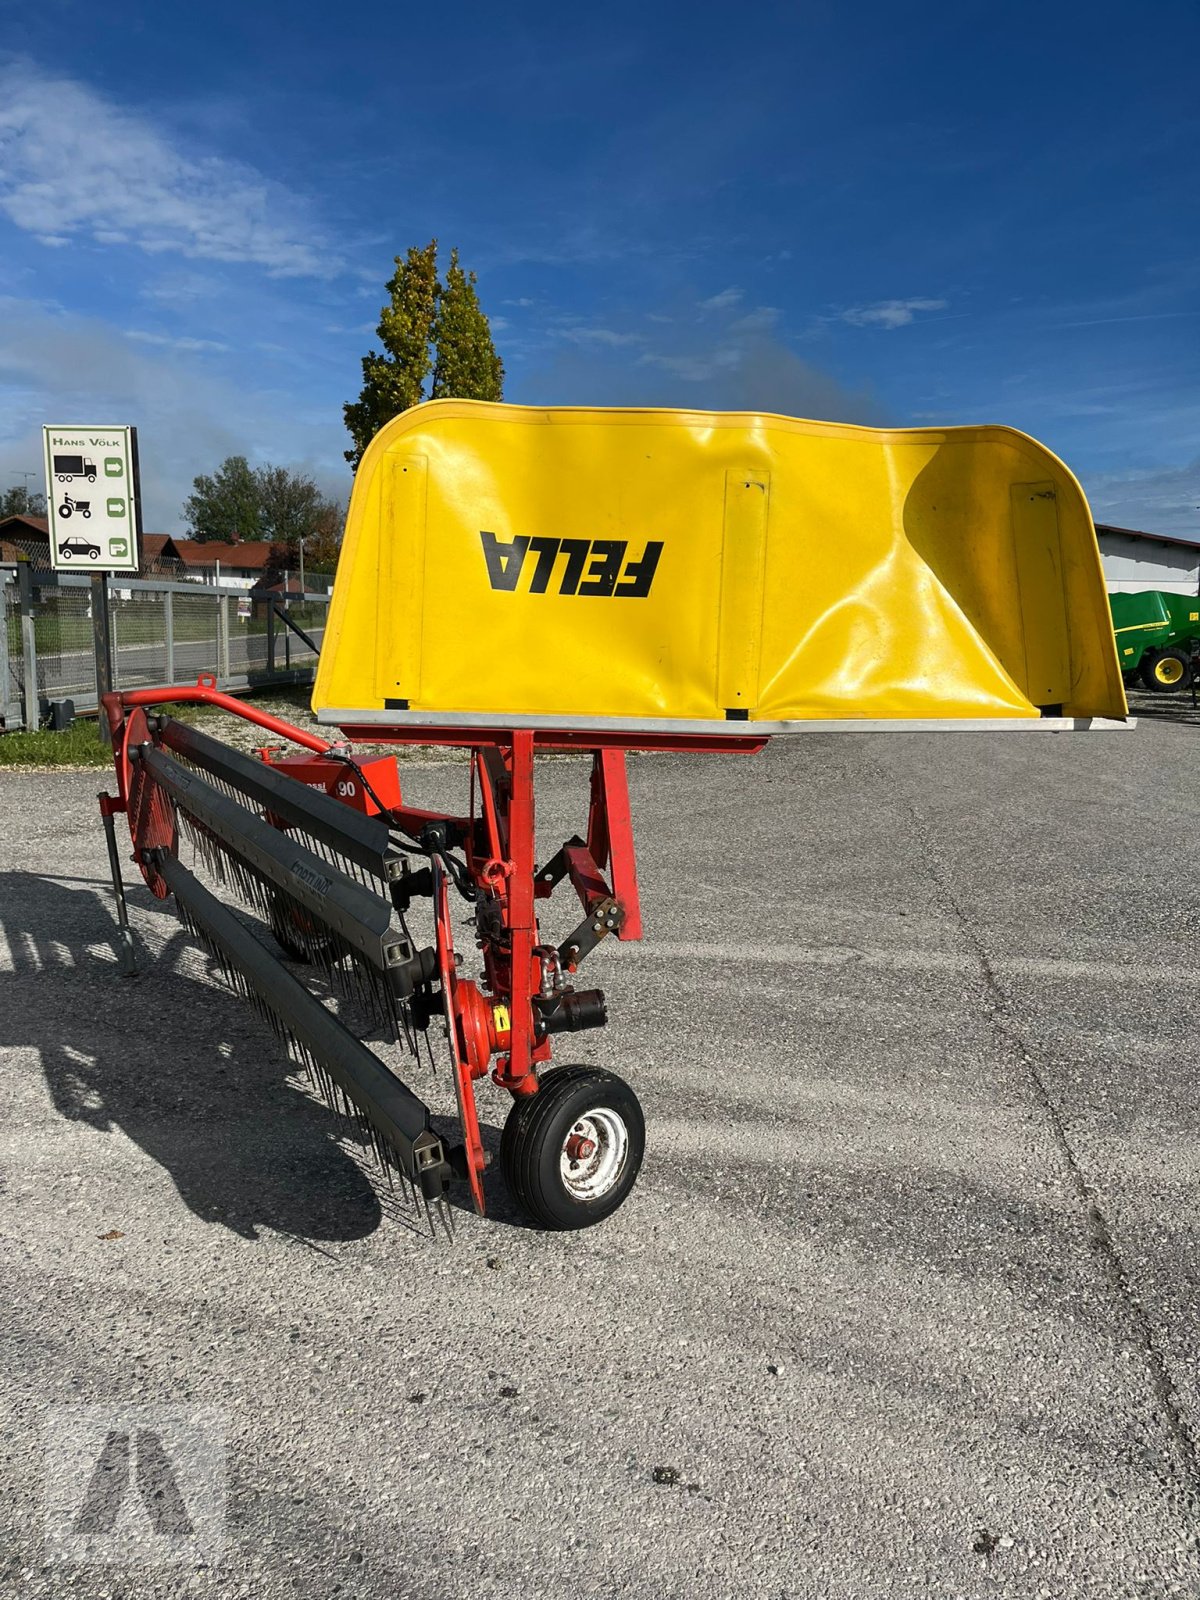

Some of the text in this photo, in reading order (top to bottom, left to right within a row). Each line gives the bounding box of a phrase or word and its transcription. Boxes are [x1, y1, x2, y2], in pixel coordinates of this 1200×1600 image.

[52, 437, 86, 447] HANS
[479, 530, 665, 598] FELLA
[338, 781, 356, 797] 90
